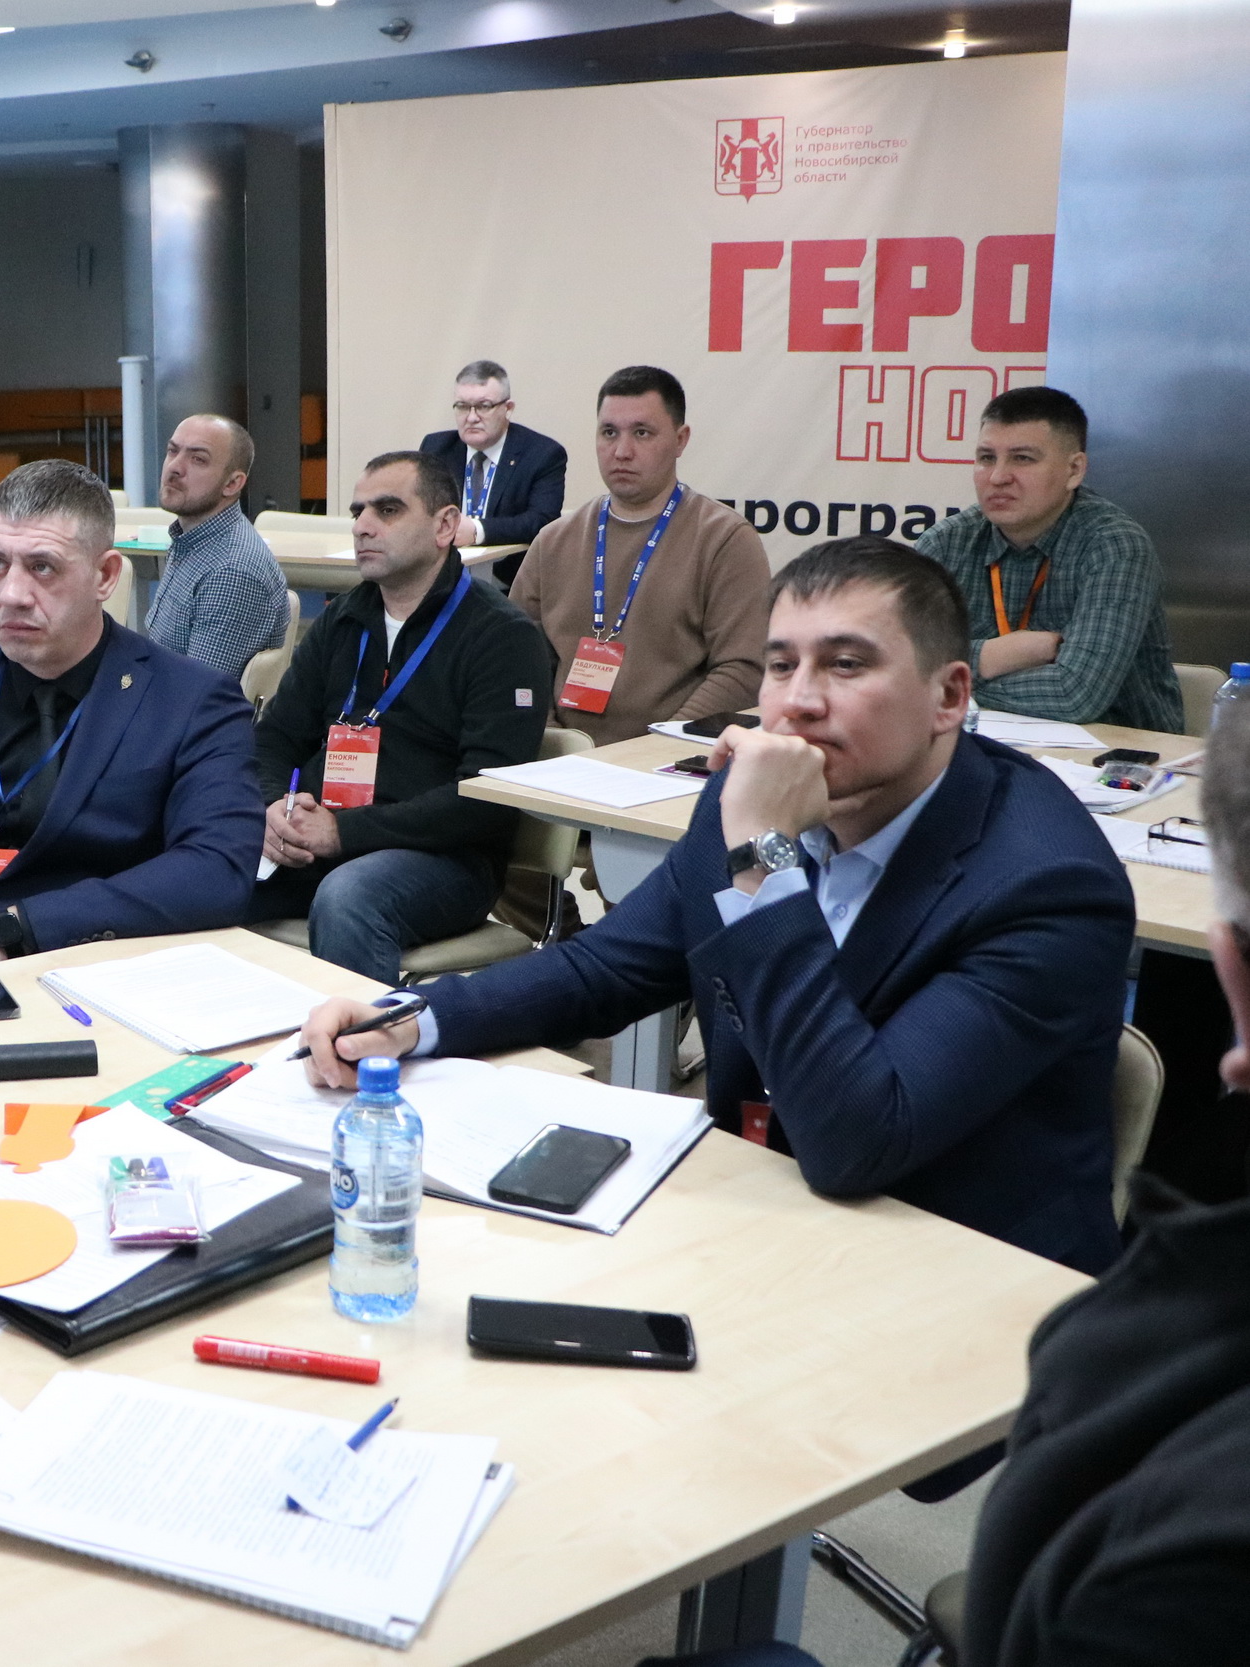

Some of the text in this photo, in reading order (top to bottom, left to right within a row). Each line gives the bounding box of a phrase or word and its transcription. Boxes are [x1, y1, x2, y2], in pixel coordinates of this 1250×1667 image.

[795, 124, 873, 139] Губернатор
[795, 139, 908, 153] и правительство
[795, 153, 898, 167] Новосибирской
[794, 171, 847, 183] области
[708, 234, 1055, 352] ГЕРО
[836, 365, 1047, 465] НО
